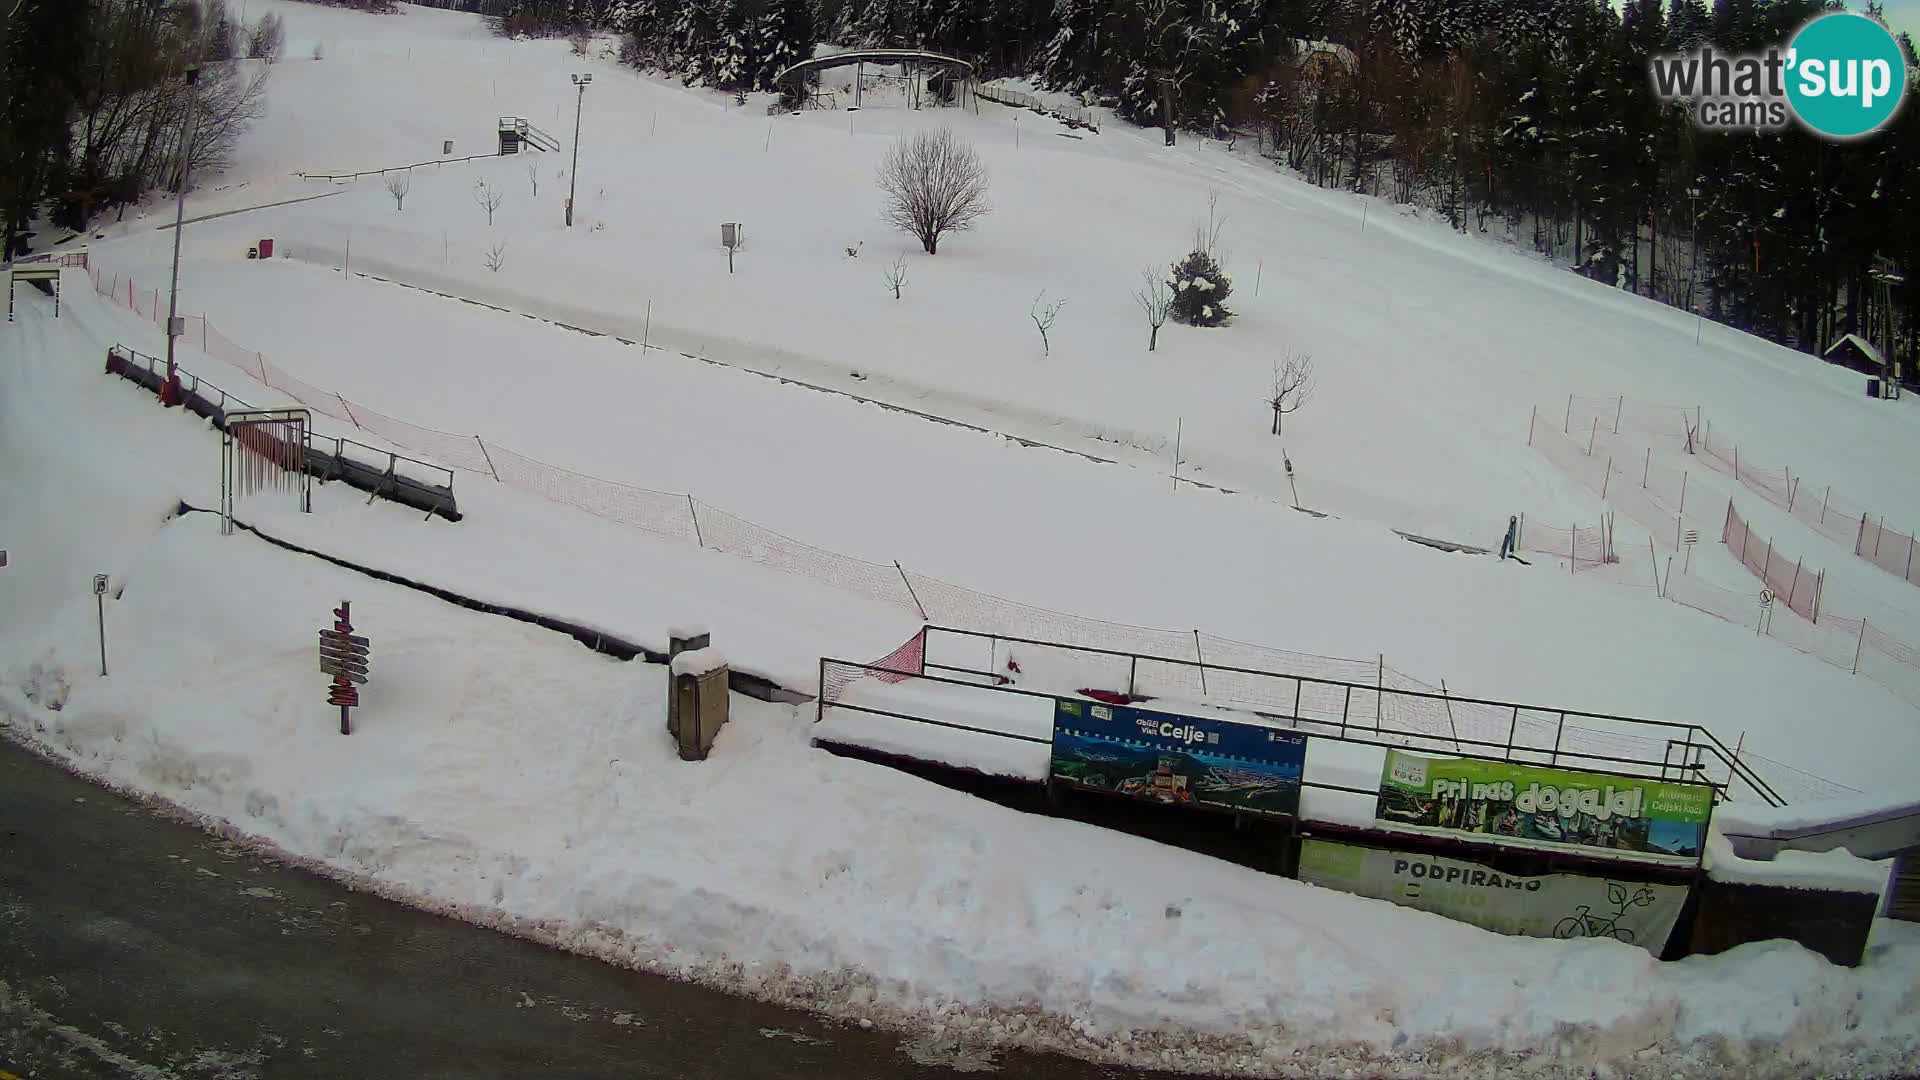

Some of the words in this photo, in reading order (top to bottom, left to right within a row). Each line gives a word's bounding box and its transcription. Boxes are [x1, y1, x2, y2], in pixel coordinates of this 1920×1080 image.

[1141, 727, 1159, 736] Visit
[1159, 722, 1205, 745] Celje
[1431, 777, 1468, 801] Pri
[1471, 780, 1515, 803] nas
[1515, 782, 1644, 821] dogaja!
[1651, 800, 1682, 813] Celjski
[1393, 858, 1542, 893] PODPIRAMO
